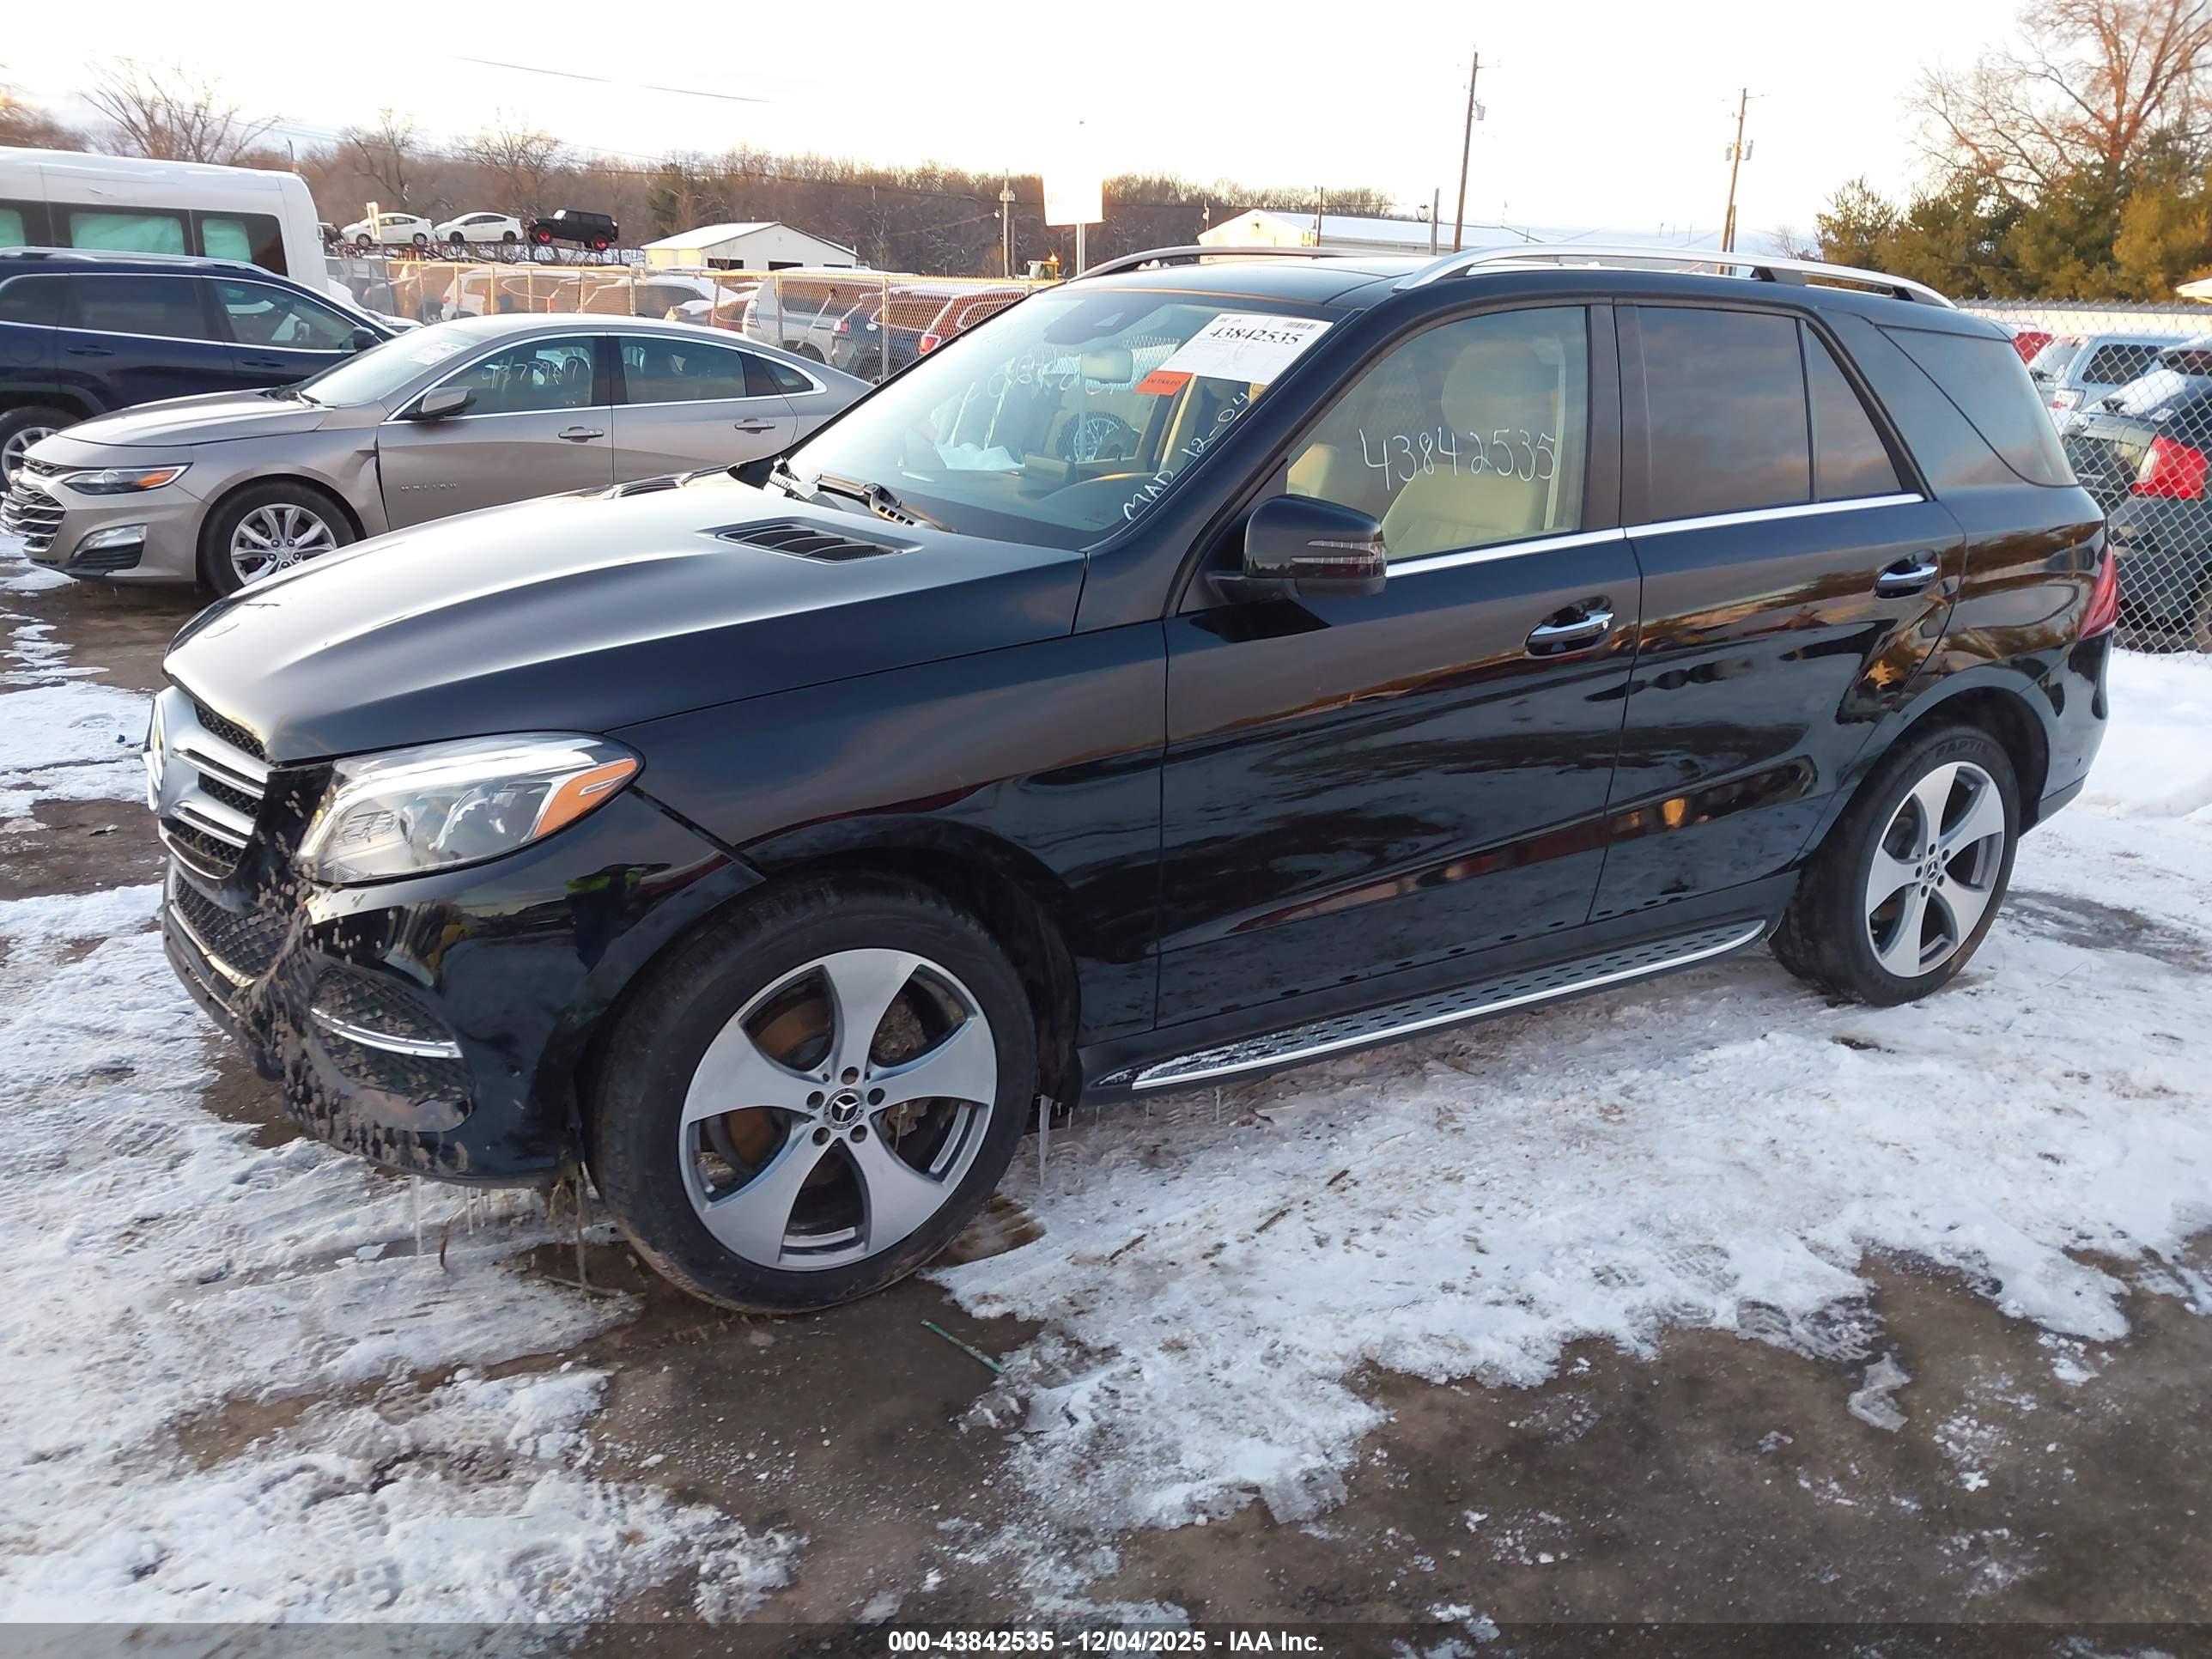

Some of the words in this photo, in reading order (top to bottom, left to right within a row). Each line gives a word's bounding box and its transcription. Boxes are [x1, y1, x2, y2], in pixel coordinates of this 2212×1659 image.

[1209, 326, 1304, 345] 43842535
[1122, 470, 1175, 521] MAD
[1181, 392, 1250, 459] 12-04
[1358, 426, 1556, 491] 43842535
